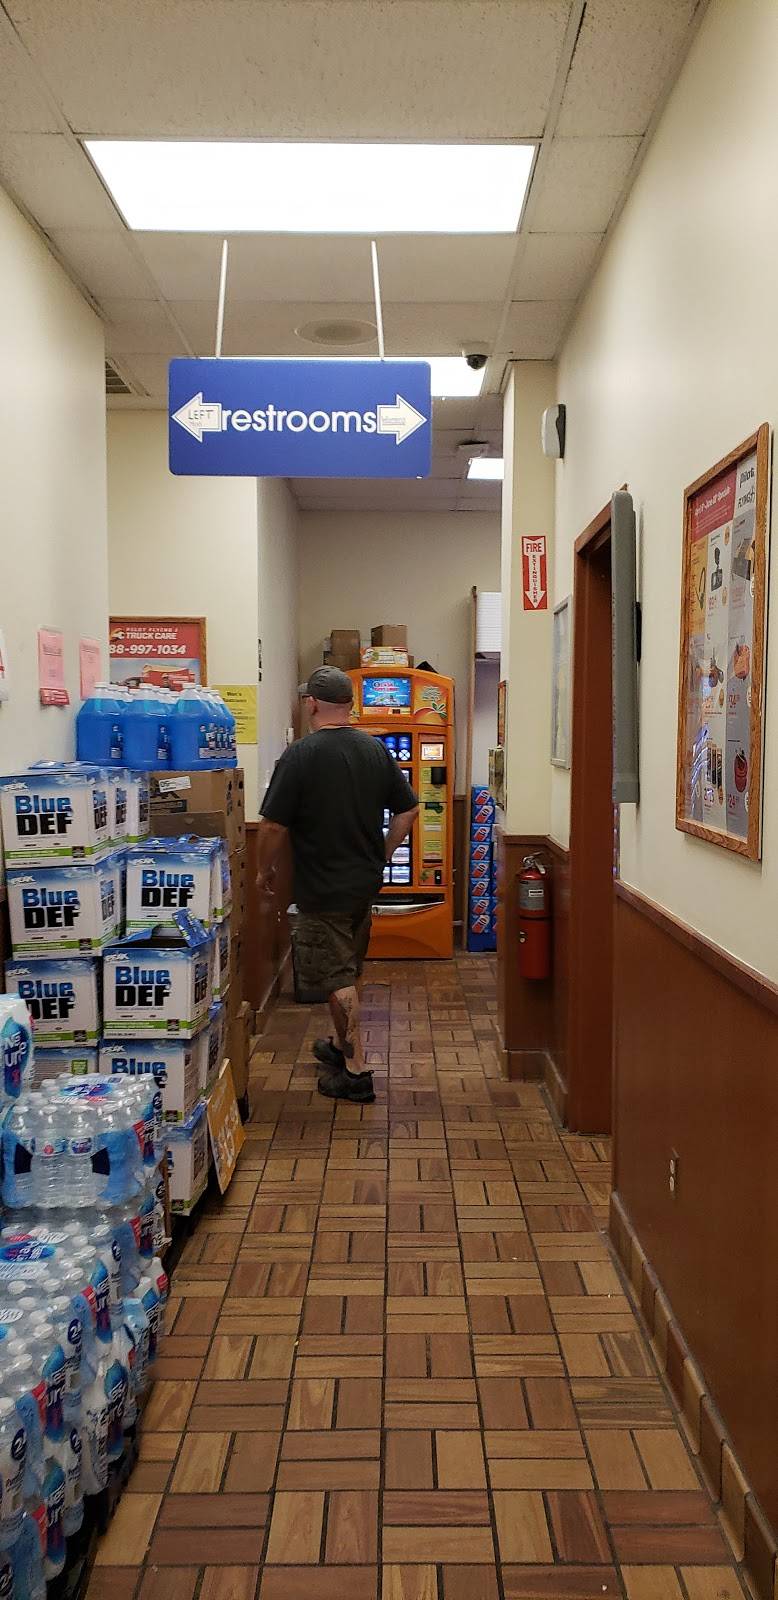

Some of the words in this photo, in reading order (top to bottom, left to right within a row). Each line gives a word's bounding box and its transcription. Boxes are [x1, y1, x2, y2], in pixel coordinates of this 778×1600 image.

[188, 408, 215, 420] LEFT
[221, 405, 377, 433] restrooms
[526, 542, 542, 553] FIRE
[126, 632, 154, 640] TRUCK
[154, 632, 178, 640] CARE
[14, 794, 71, 815] Blue
[15, 813, 74, 836] DEF
[141, 869, 194, 888] Blue
[21, 887, 79, 908] Blue
[141, 887, 194, 907] DEF
[23, 905, 81, 929] DEF
[115, 966, 170, 985] Blue
[18, 980, 74, 1000] Blue
[115, 985, 170, 1007] DEF
[26, 998, 75, 1020] DEF
[111, 1057, 167, 1079] Blue
